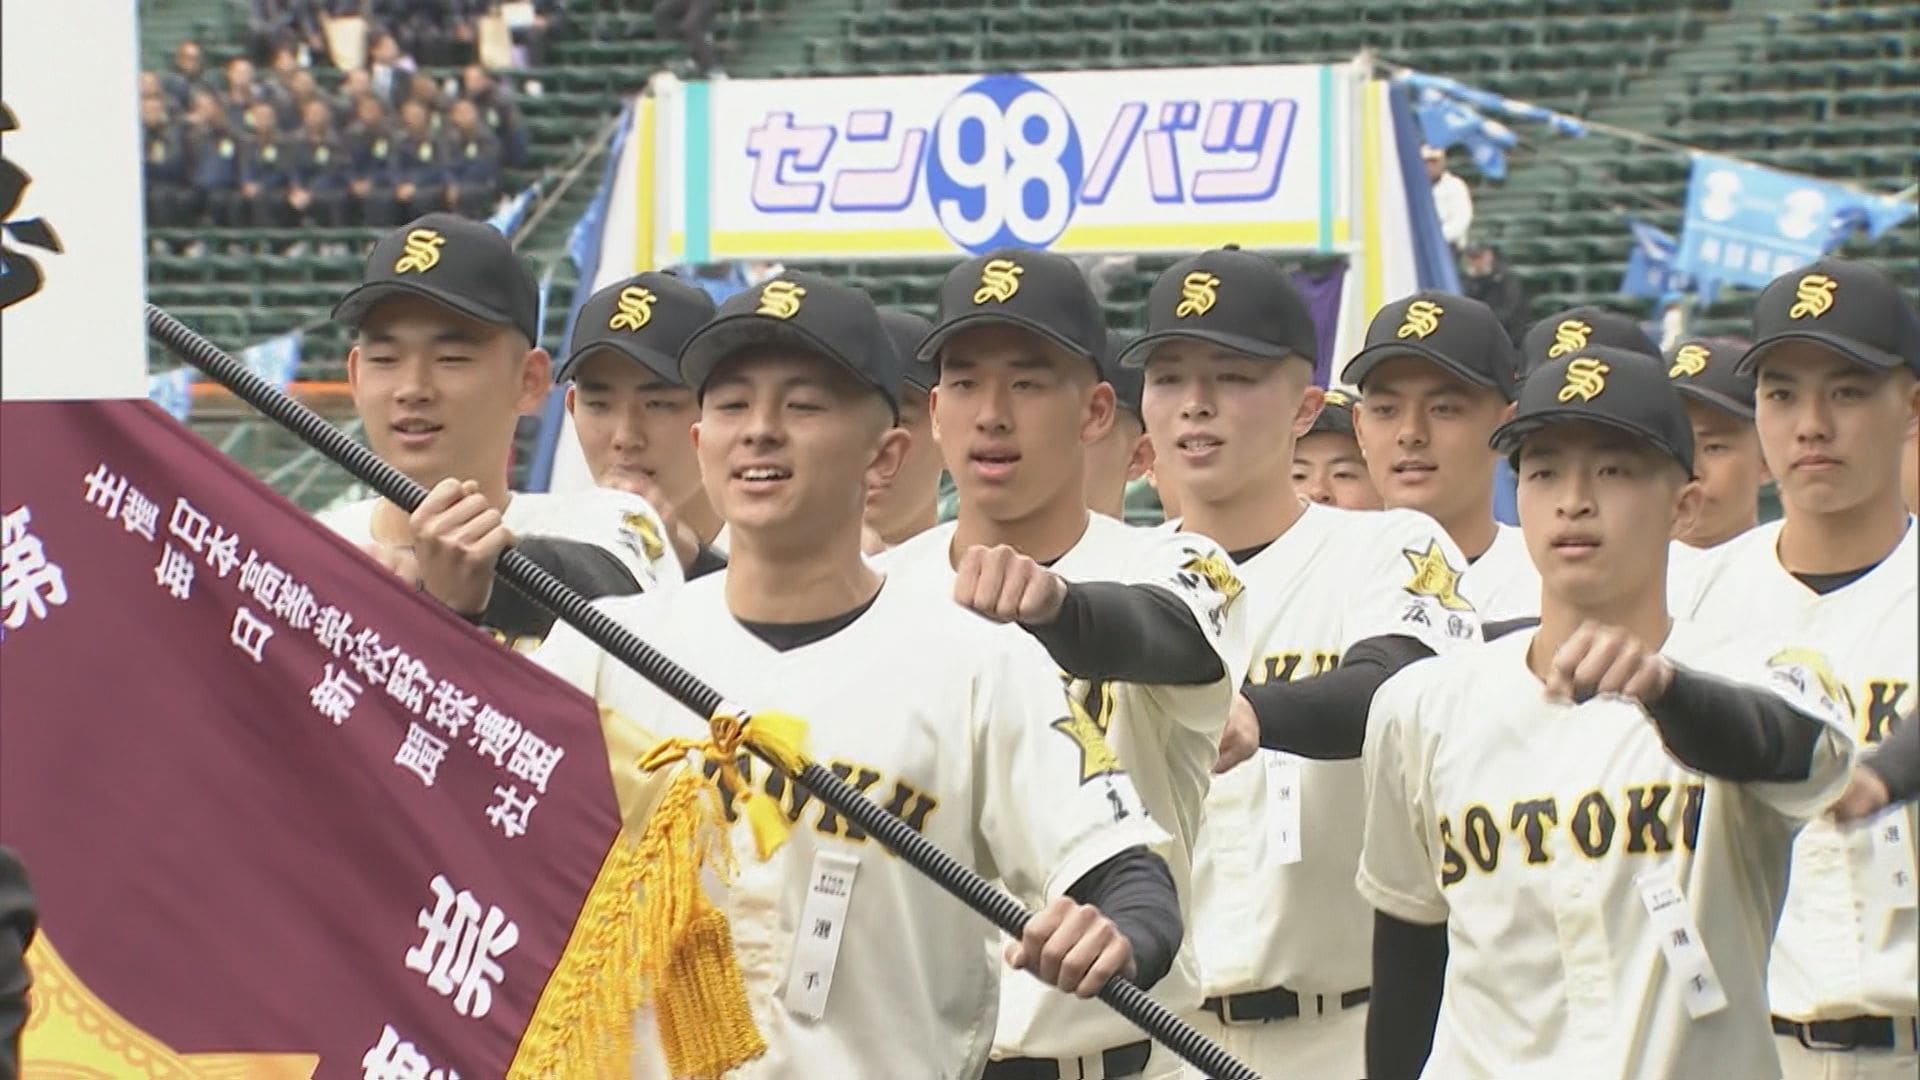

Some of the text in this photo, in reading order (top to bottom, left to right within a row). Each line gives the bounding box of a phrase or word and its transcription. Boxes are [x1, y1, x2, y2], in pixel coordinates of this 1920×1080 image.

[745, 91, 1297, 246] セン 98 バツ
[393, 228, 445, 273] S
[757, 281, 806, 320] S
[972, 259, 1024, 304] S
[1175, 271, 1220, 318] S
[1788, 273, 1838, 319] S
[608, 286, 657, 332] S
[1396, 301, 1444, 340] S
[1549, 320, 1592, 358] S
[1557, 358, 1611, 403] S
[84, 463, 160, 542] 主催
[168, 497, 565, 794] 日本高等学校野球連盟
